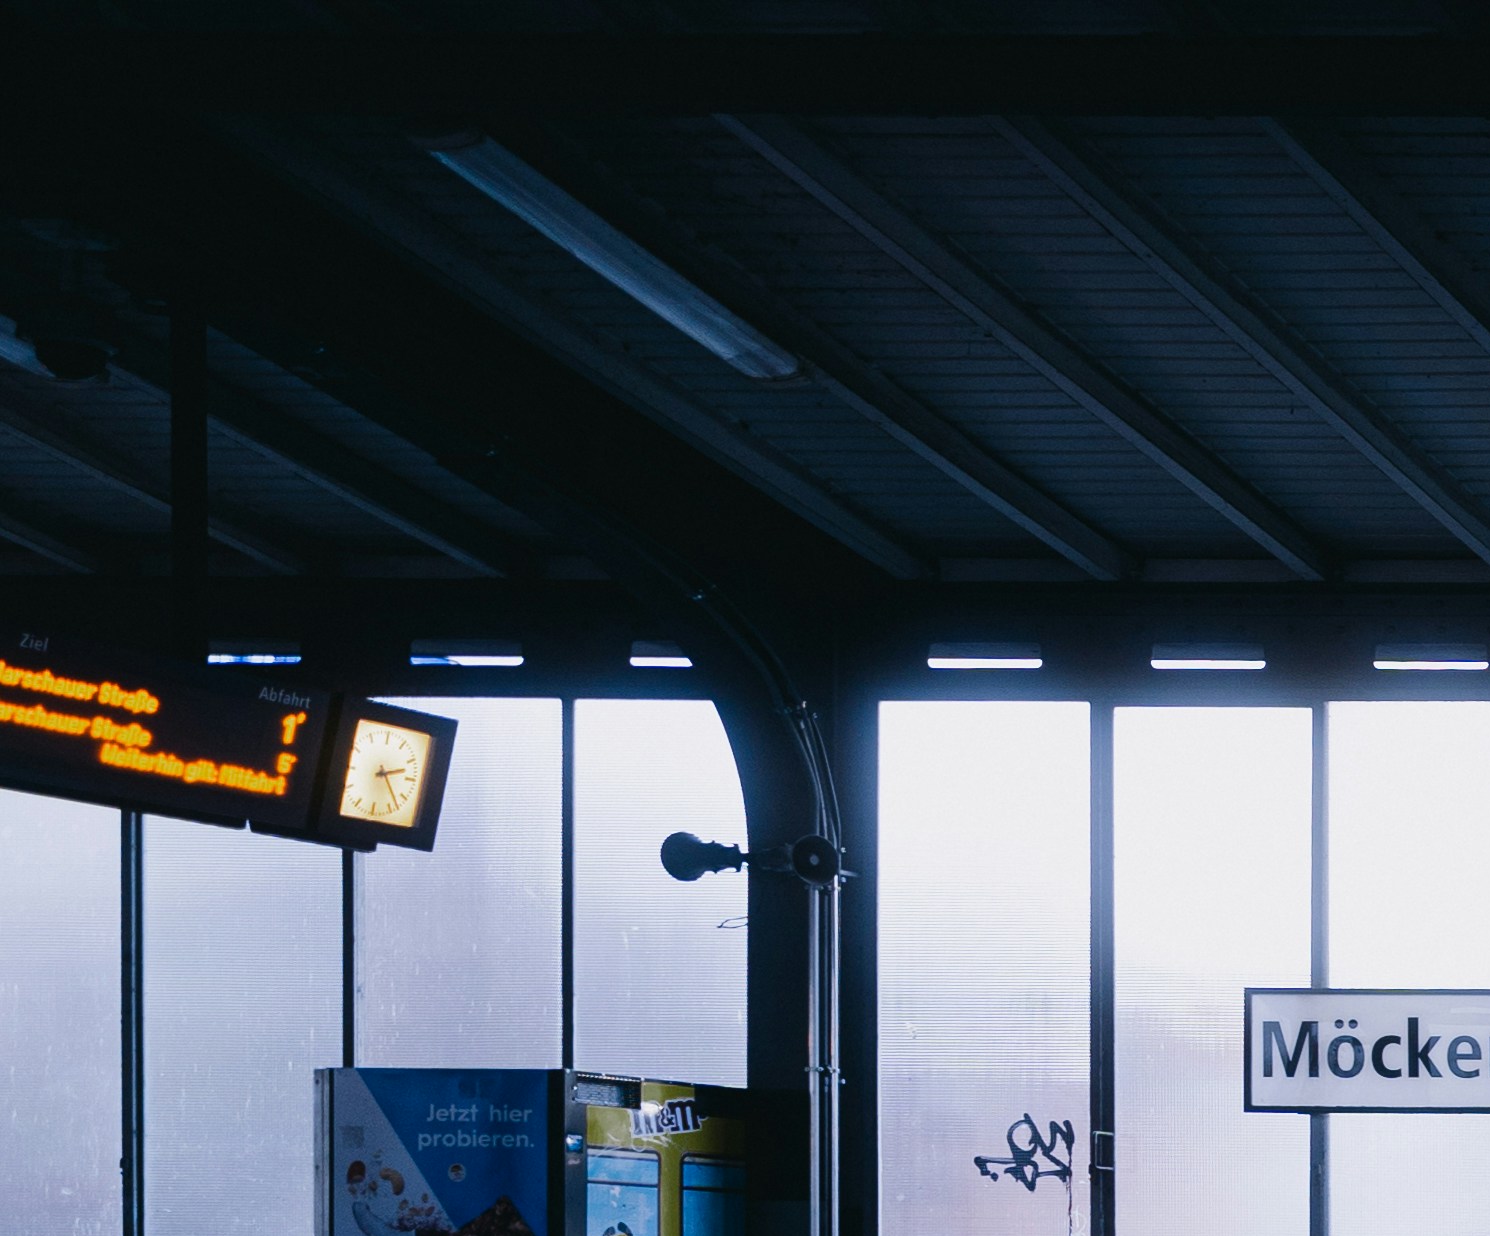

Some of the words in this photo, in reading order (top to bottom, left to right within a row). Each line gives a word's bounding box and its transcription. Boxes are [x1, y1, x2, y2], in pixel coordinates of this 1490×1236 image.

[20, 632, 49, 651] Ziel
[98, 681, 160, 714] Straße
[259, 686, 311, 708] Abfahrt
[0, 702, 91, 735] arschauer
[90, 716, 153, 747] Straße
[100, 743, 185, 777] Weiterhin
[217, 763, 287, 795] Mitfahrt
[426, 1103, 479, 1122] Jetzt
[489, 1103, 533, 1122] hier
[417, 1129, 535, 1152] probieren.
